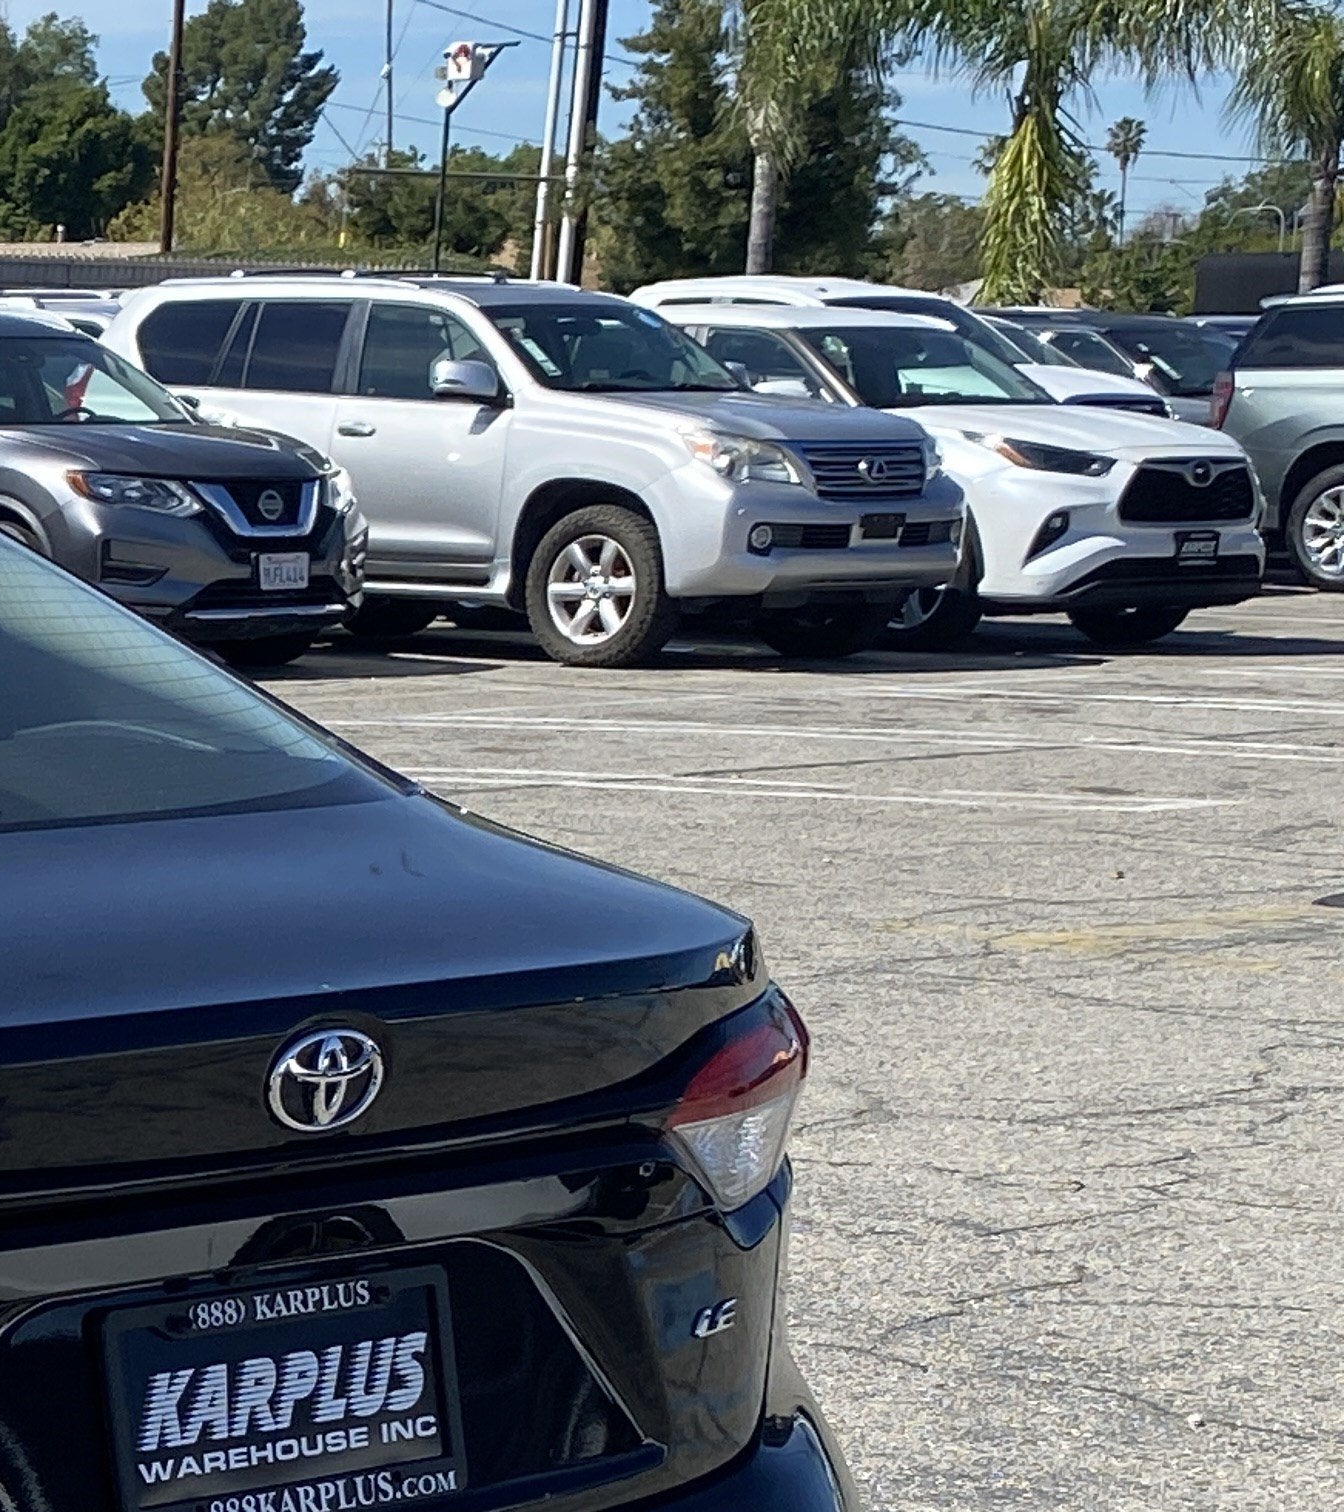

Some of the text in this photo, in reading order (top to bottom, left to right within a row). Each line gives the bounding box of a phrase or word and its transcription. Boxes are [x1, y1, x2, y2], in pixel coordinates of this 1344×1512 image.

[188, 1279, 370, 1330] (888) KARPLUS
[693, 1297, 738, 1338] LE
[136, 1330, 427, 1451] KARPLUS
[138, 1415, 437, 1484] WAREHOUSE INC
